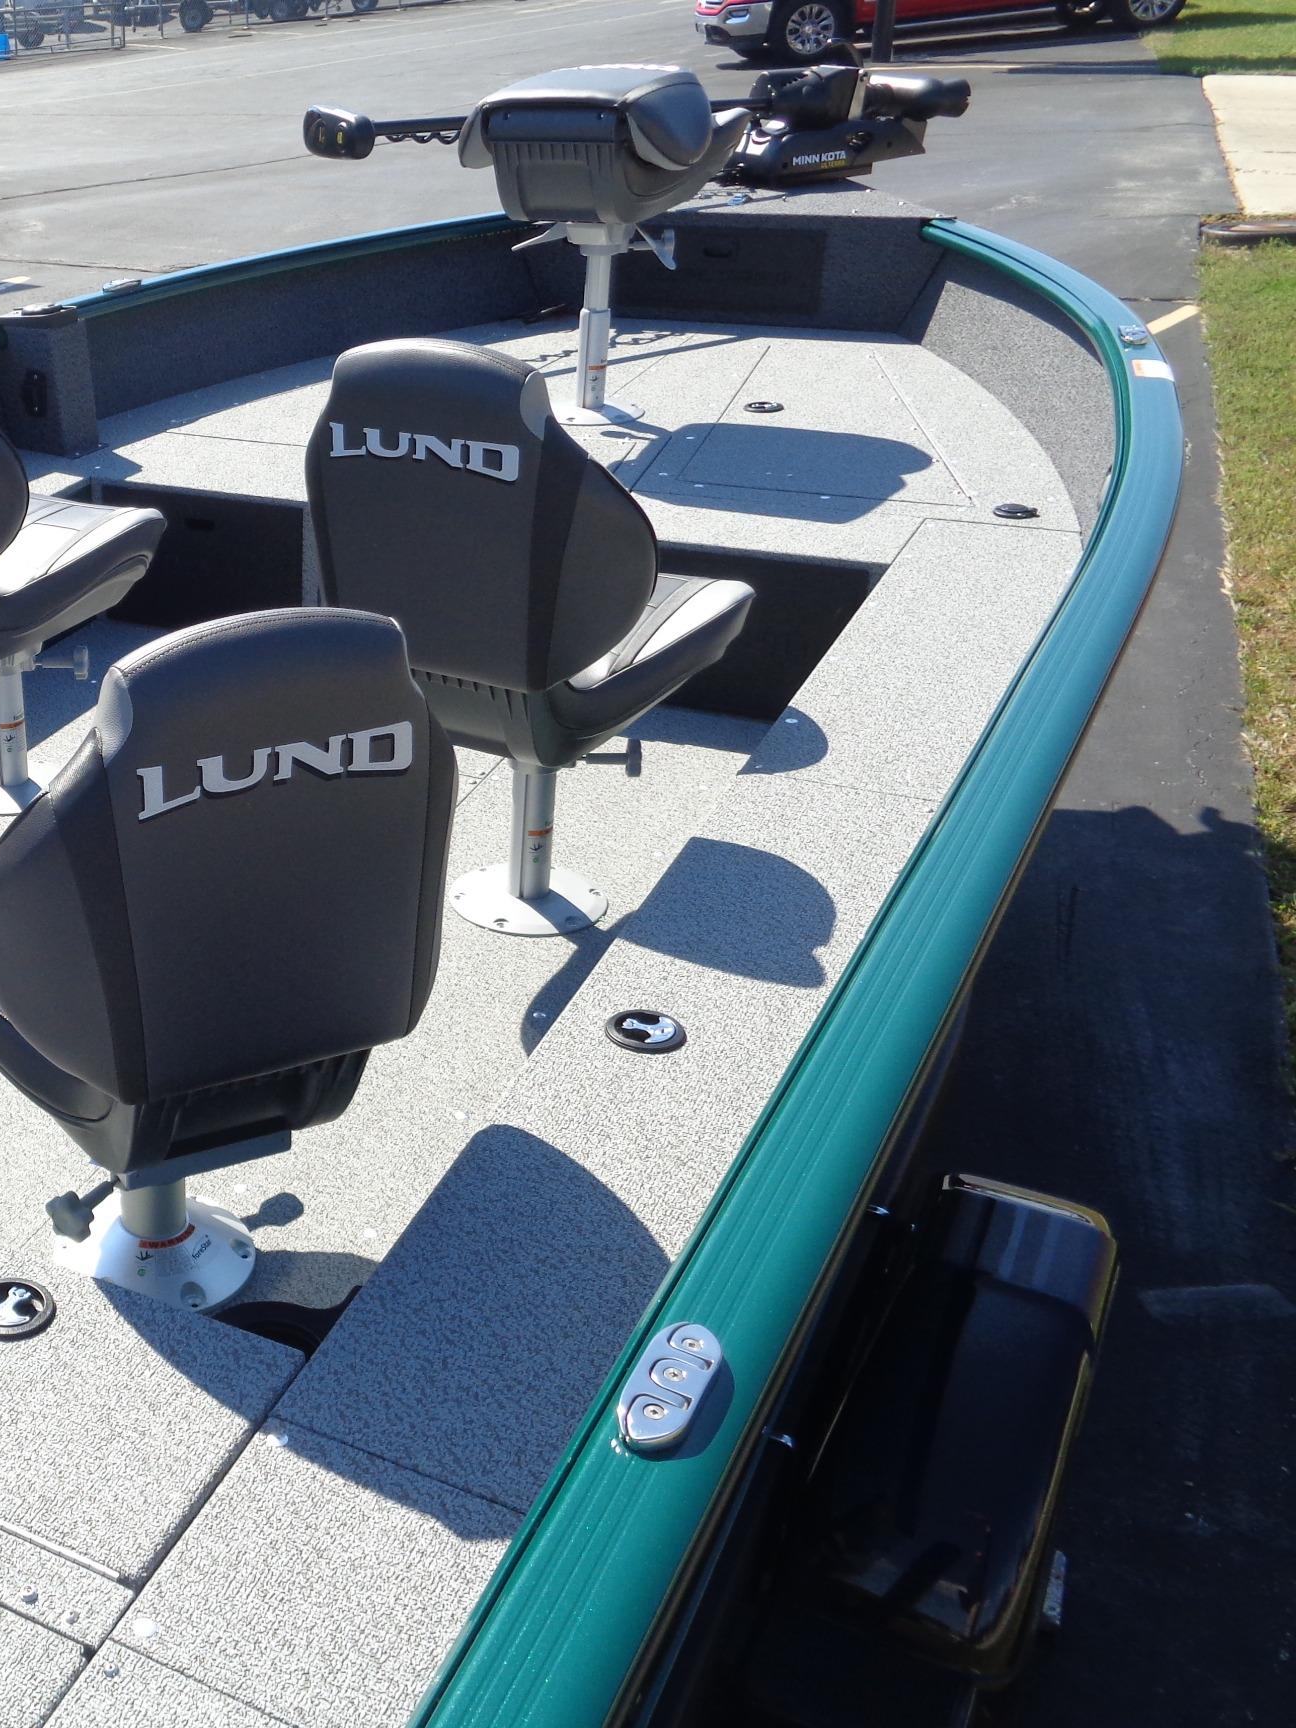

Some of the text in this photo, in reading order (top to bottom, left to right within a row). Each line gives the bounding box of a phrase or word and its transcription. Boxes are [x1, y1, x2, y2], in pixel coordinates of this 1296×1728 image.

[793, 150, 846, 166] MINN KOTA
[329, 422, 520, 482] LUND
[136, 721, 413, 821] LUND
